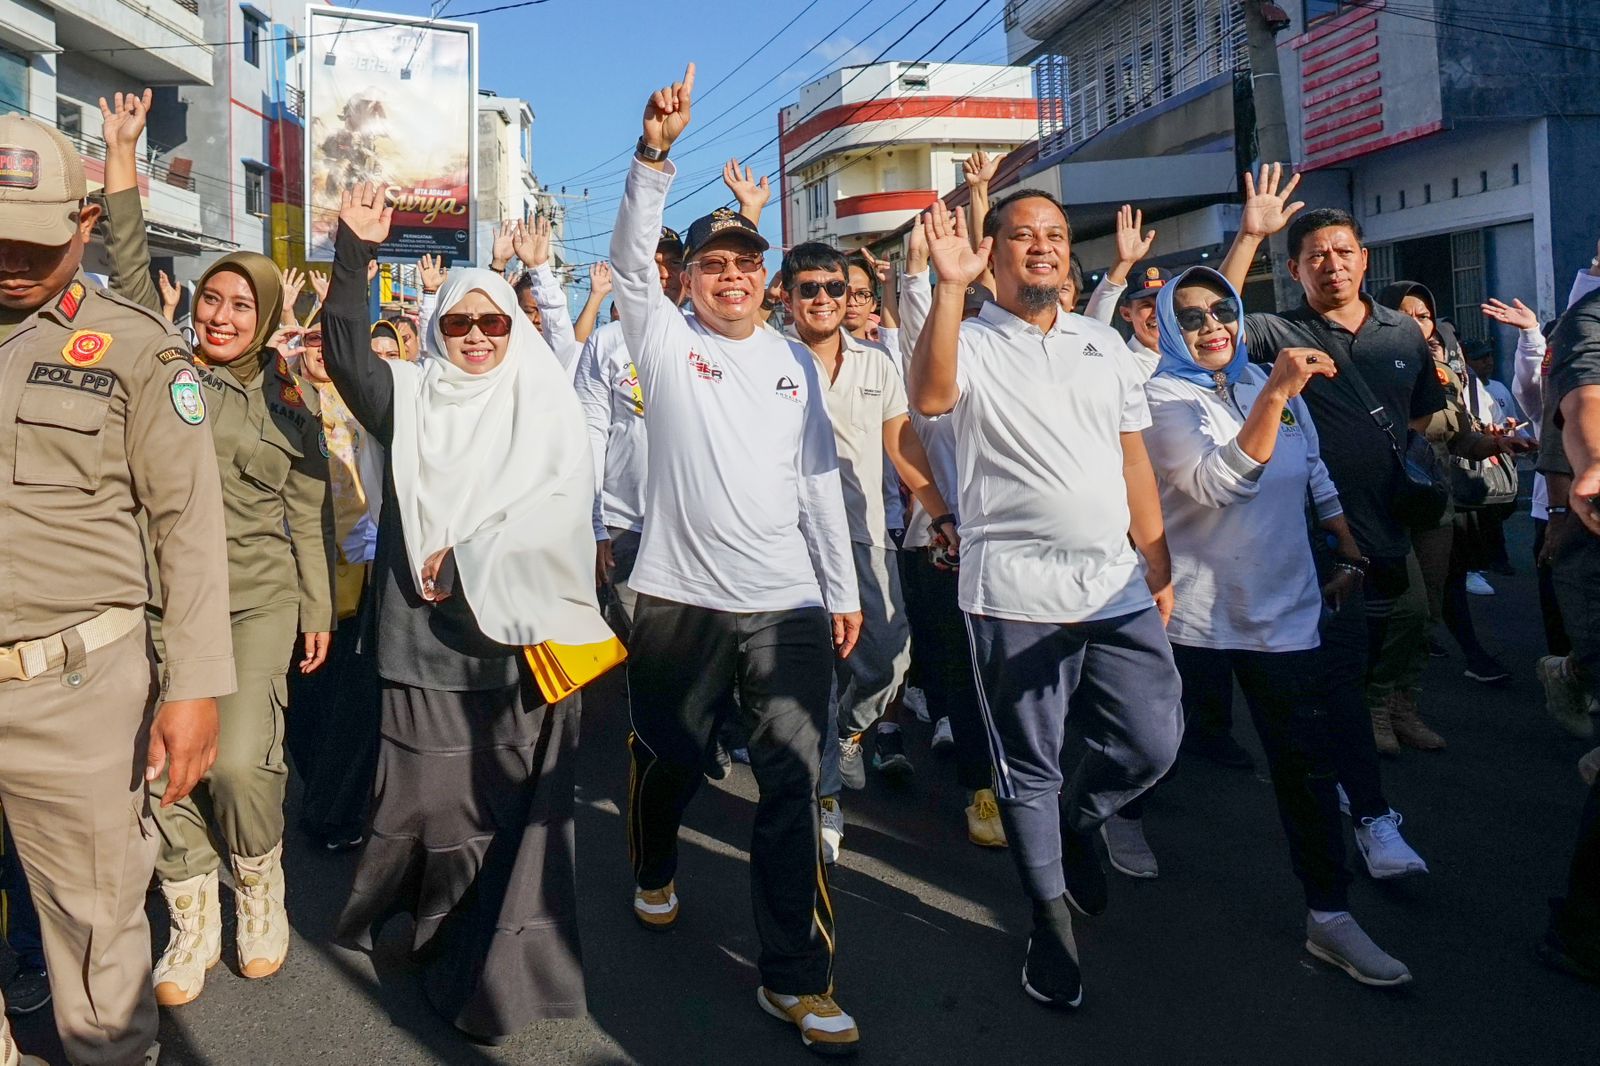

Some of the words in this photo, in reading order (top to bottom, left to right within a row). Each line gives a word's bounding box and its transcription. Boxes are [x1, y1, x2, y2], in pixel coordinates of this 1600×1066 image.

[384, 185, 466, 225] Surya
[34, 366, 73, 384] POL
[81, 373, 109, 390] PP
